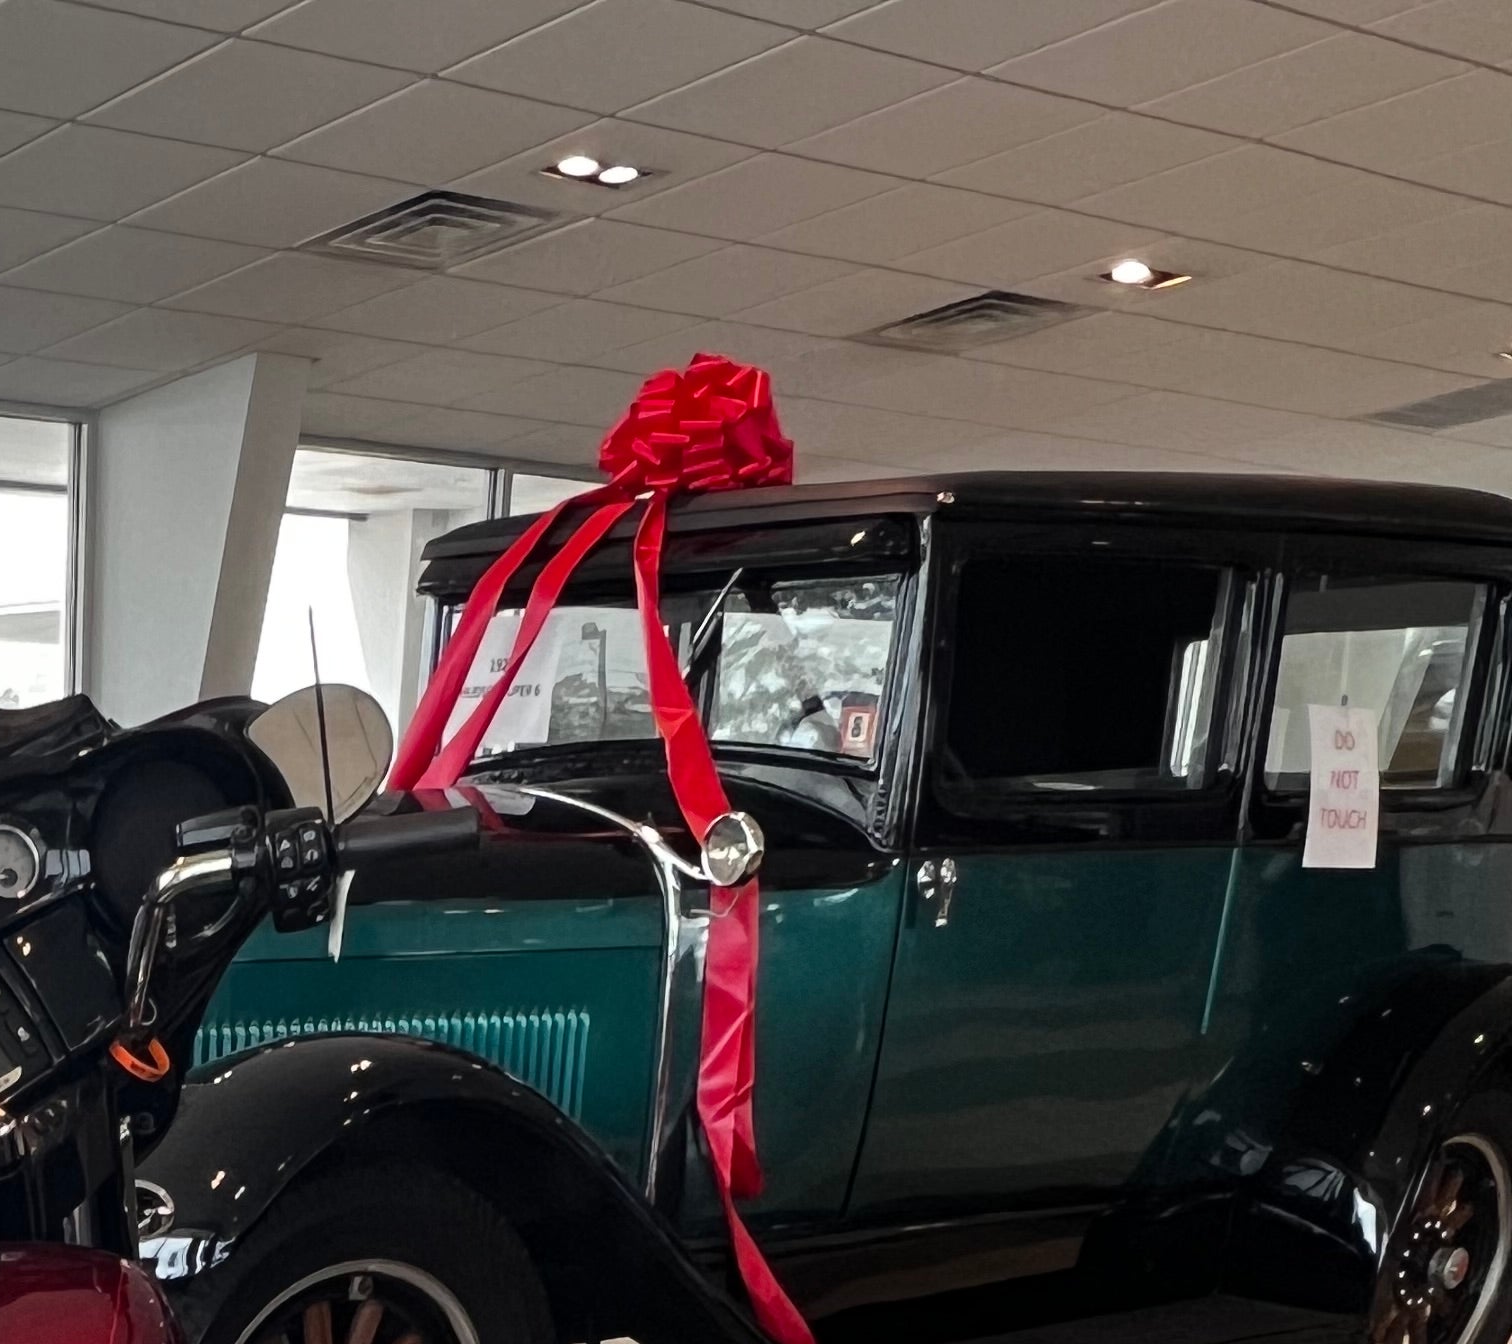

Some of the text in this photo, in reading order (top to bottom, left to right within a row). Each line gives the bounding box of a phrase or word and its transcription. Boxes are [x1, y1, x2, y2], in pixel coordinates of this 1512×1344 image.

[1334, 729, 1355, 750] DO
[1330, 770, 1360, 790] NOT
[1320, 807, 1367, 829] TOUCH
